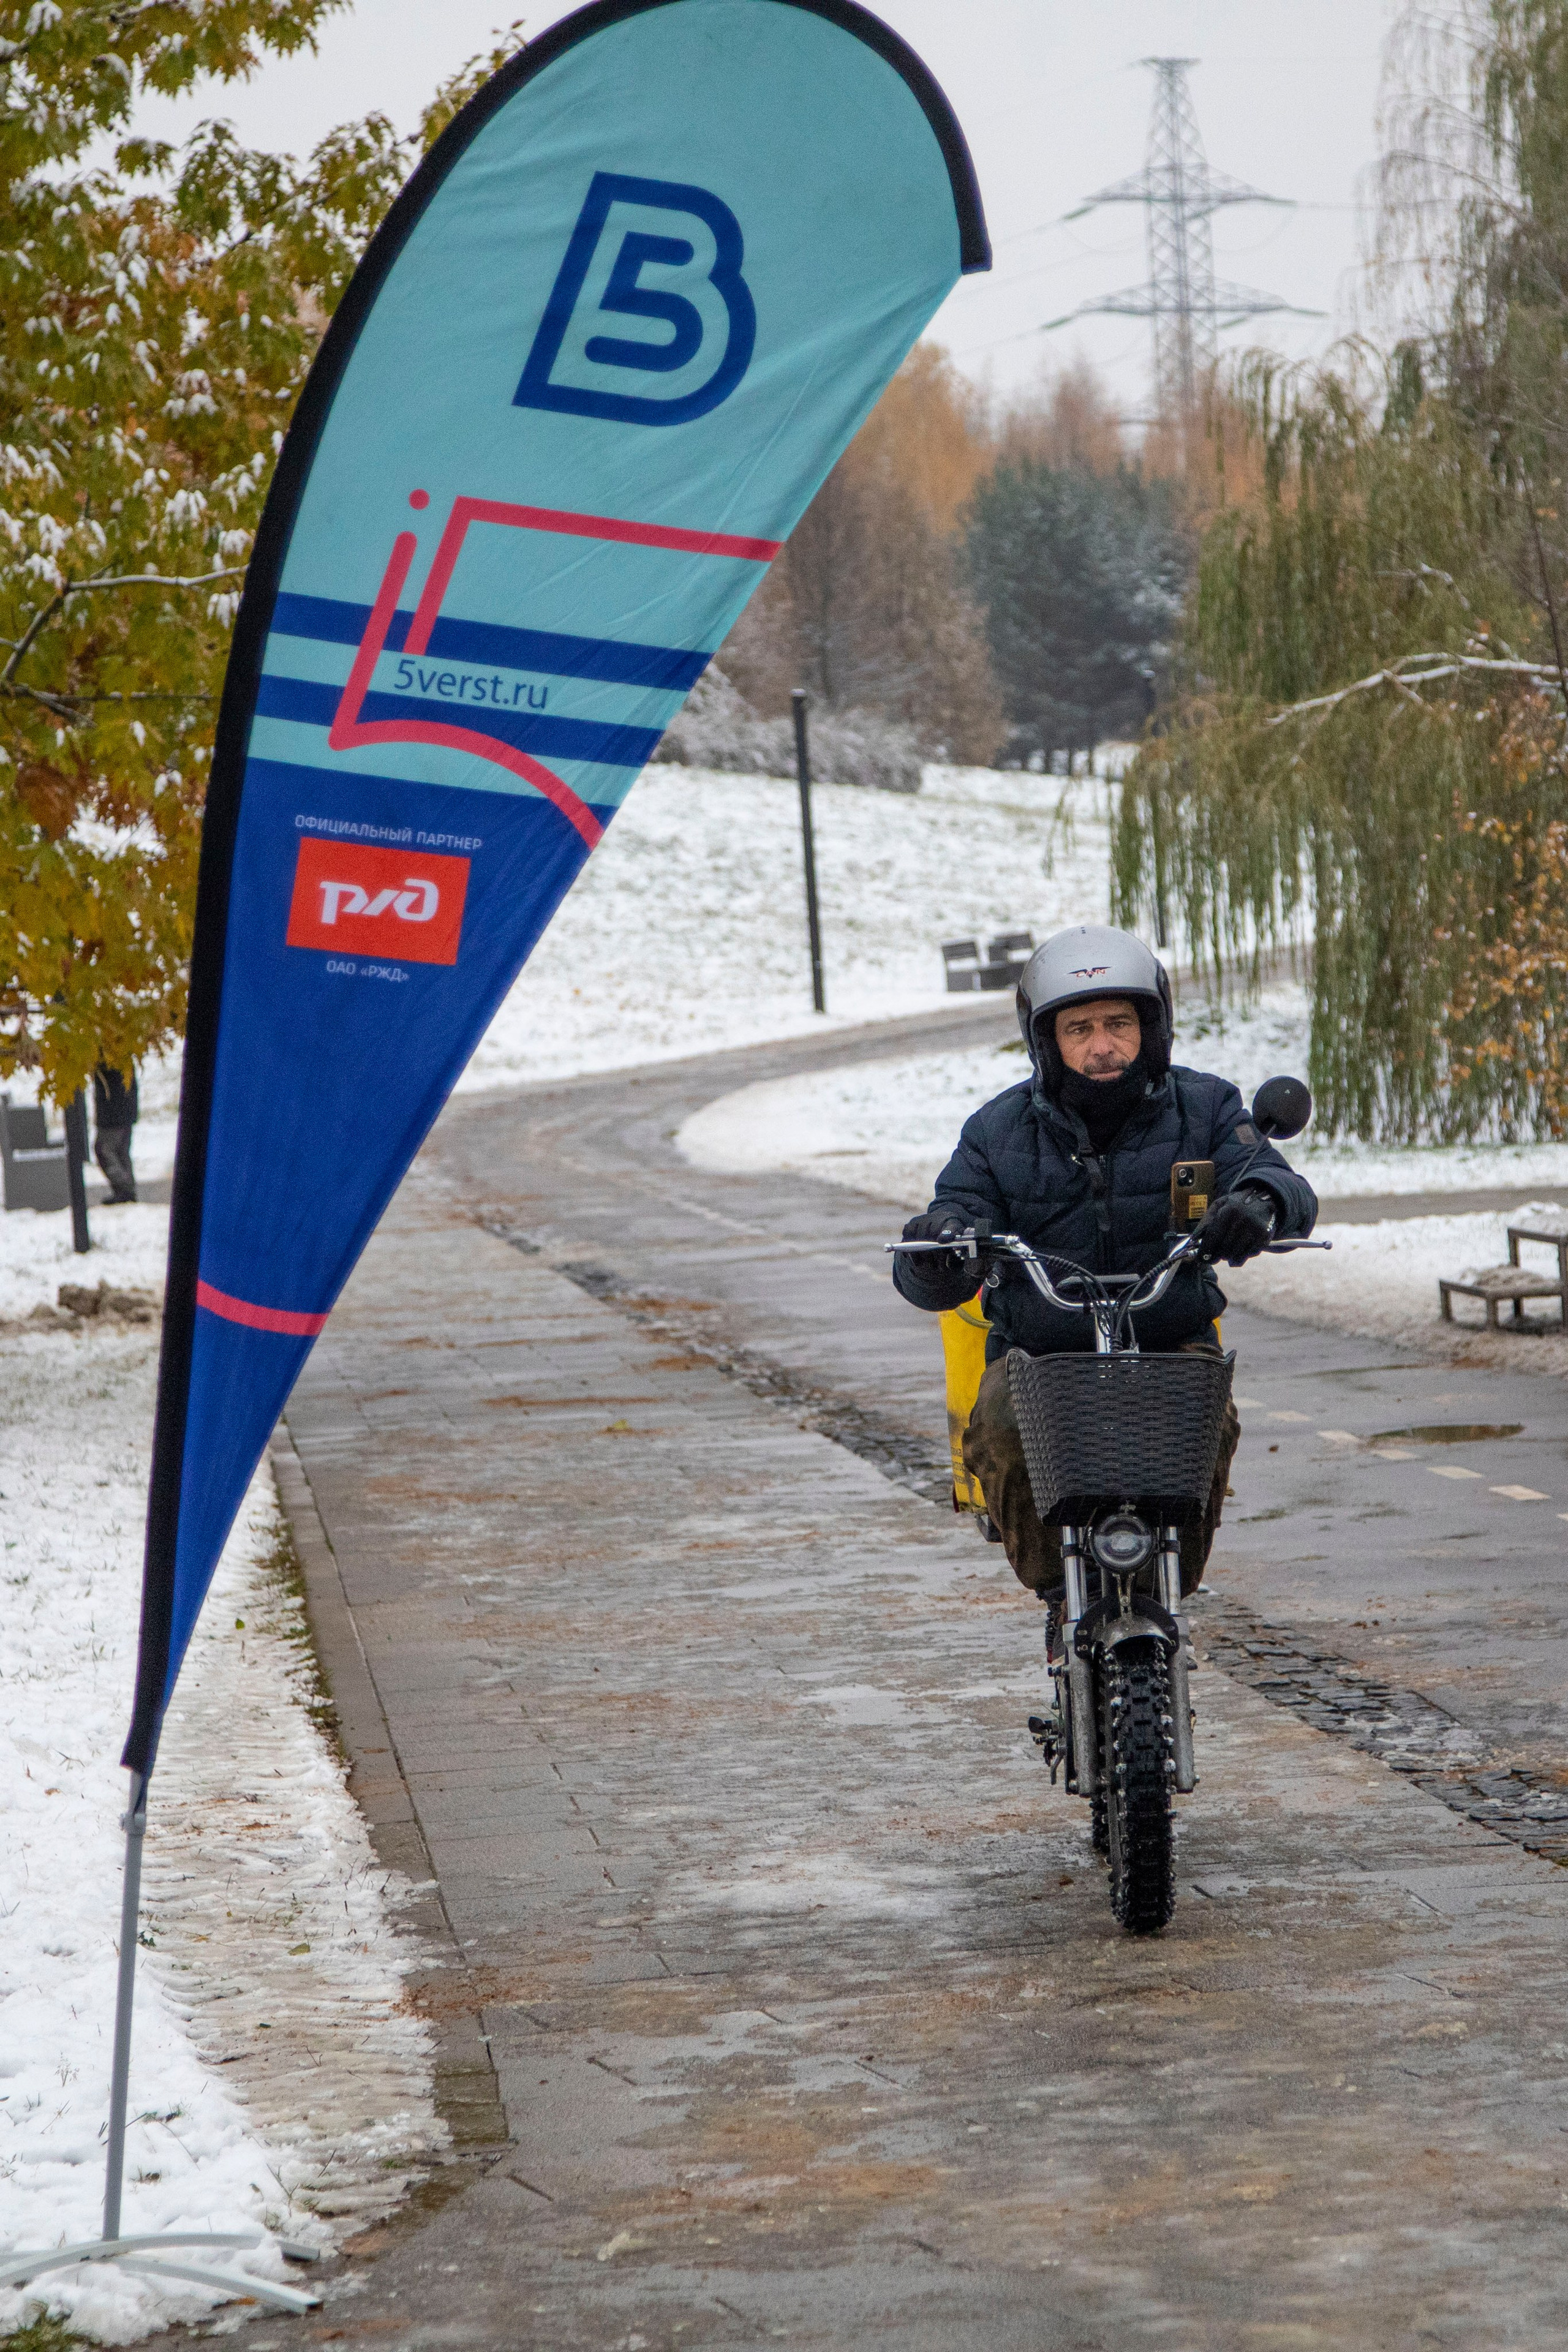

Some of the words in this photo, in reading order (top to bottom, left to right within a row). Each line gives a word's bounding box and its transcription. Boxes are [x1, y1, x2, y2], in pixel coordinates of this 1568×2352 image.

[394, 659, 548, 709] 5verst.ru
[295, 815, 412, 842] ОФИЦИАЛЬНЫЙ
[416, 831, 482, 850] ПАРТНЕР
[326, 960, 356, 974] ОАО
[360, 965, 409, 982] «РЖД»
